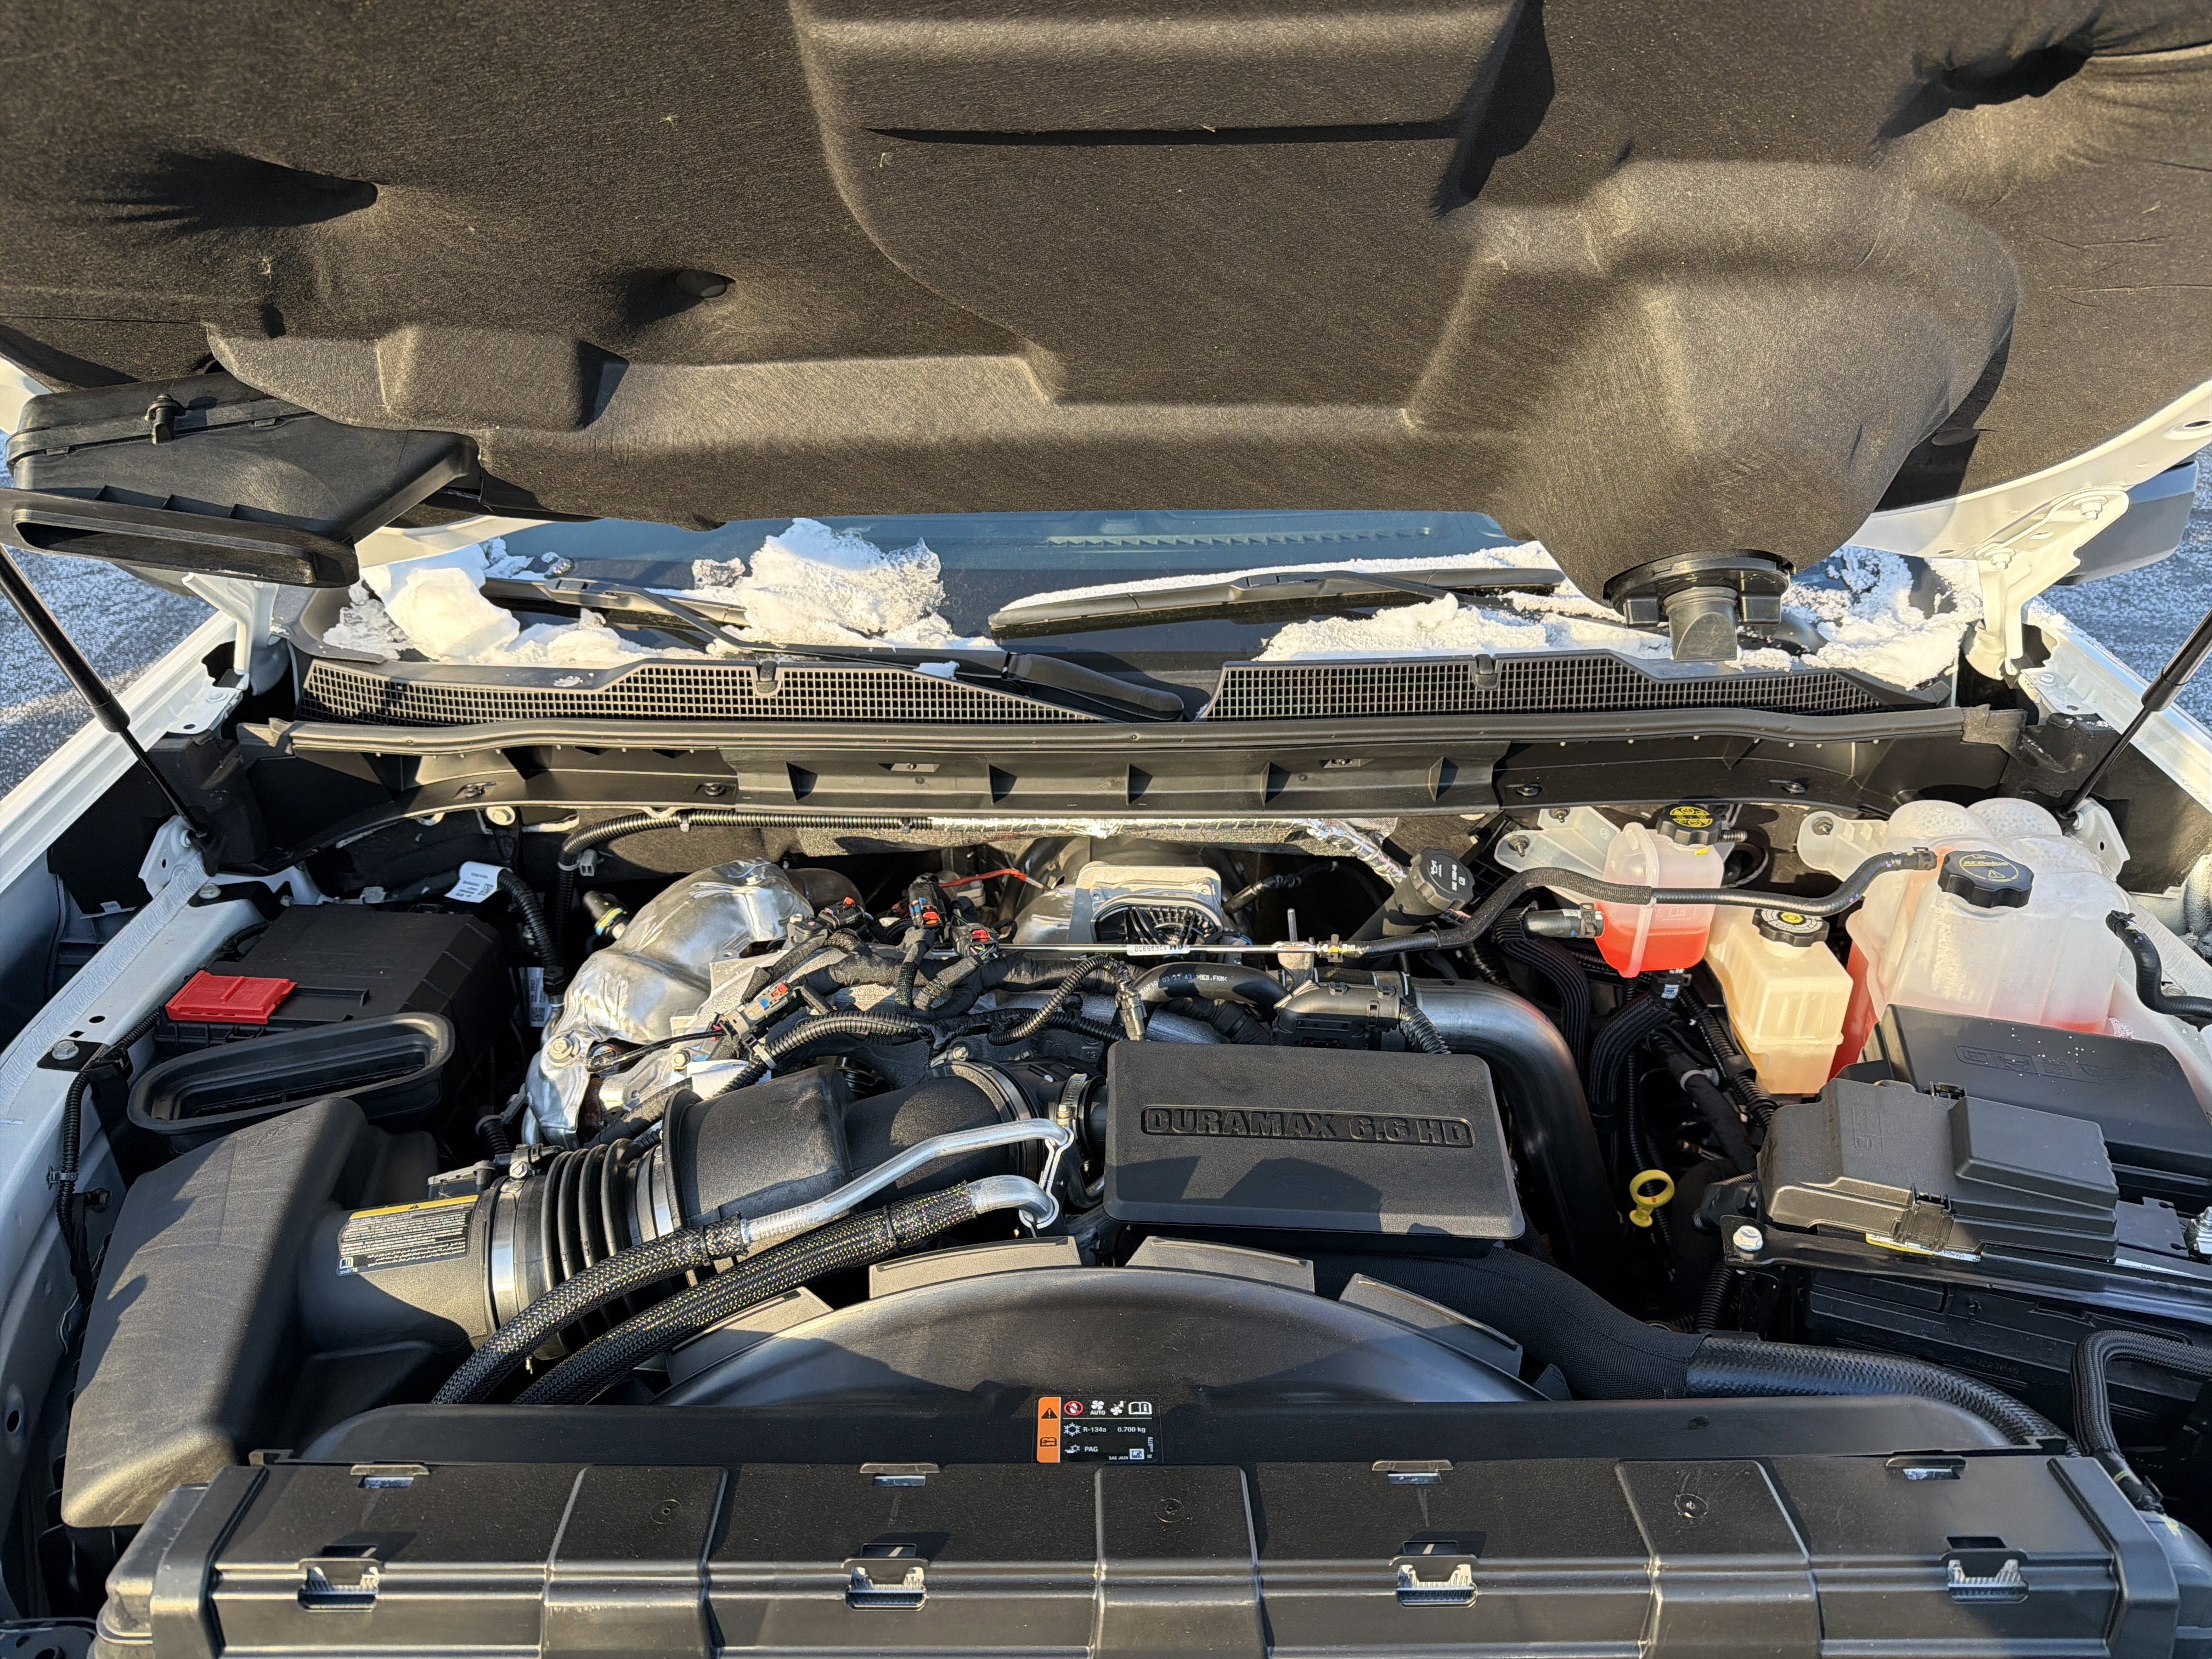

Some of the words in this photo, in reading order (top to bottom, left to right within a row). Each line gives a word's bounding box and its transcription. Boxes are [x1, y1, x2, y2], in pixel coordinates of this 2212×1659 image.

[1146, 1108, 1336, 1139] DURAMAX
[1349, 1116, 1410, 1142] 6.6
[1417, 1119, 1471, 1145] HD
